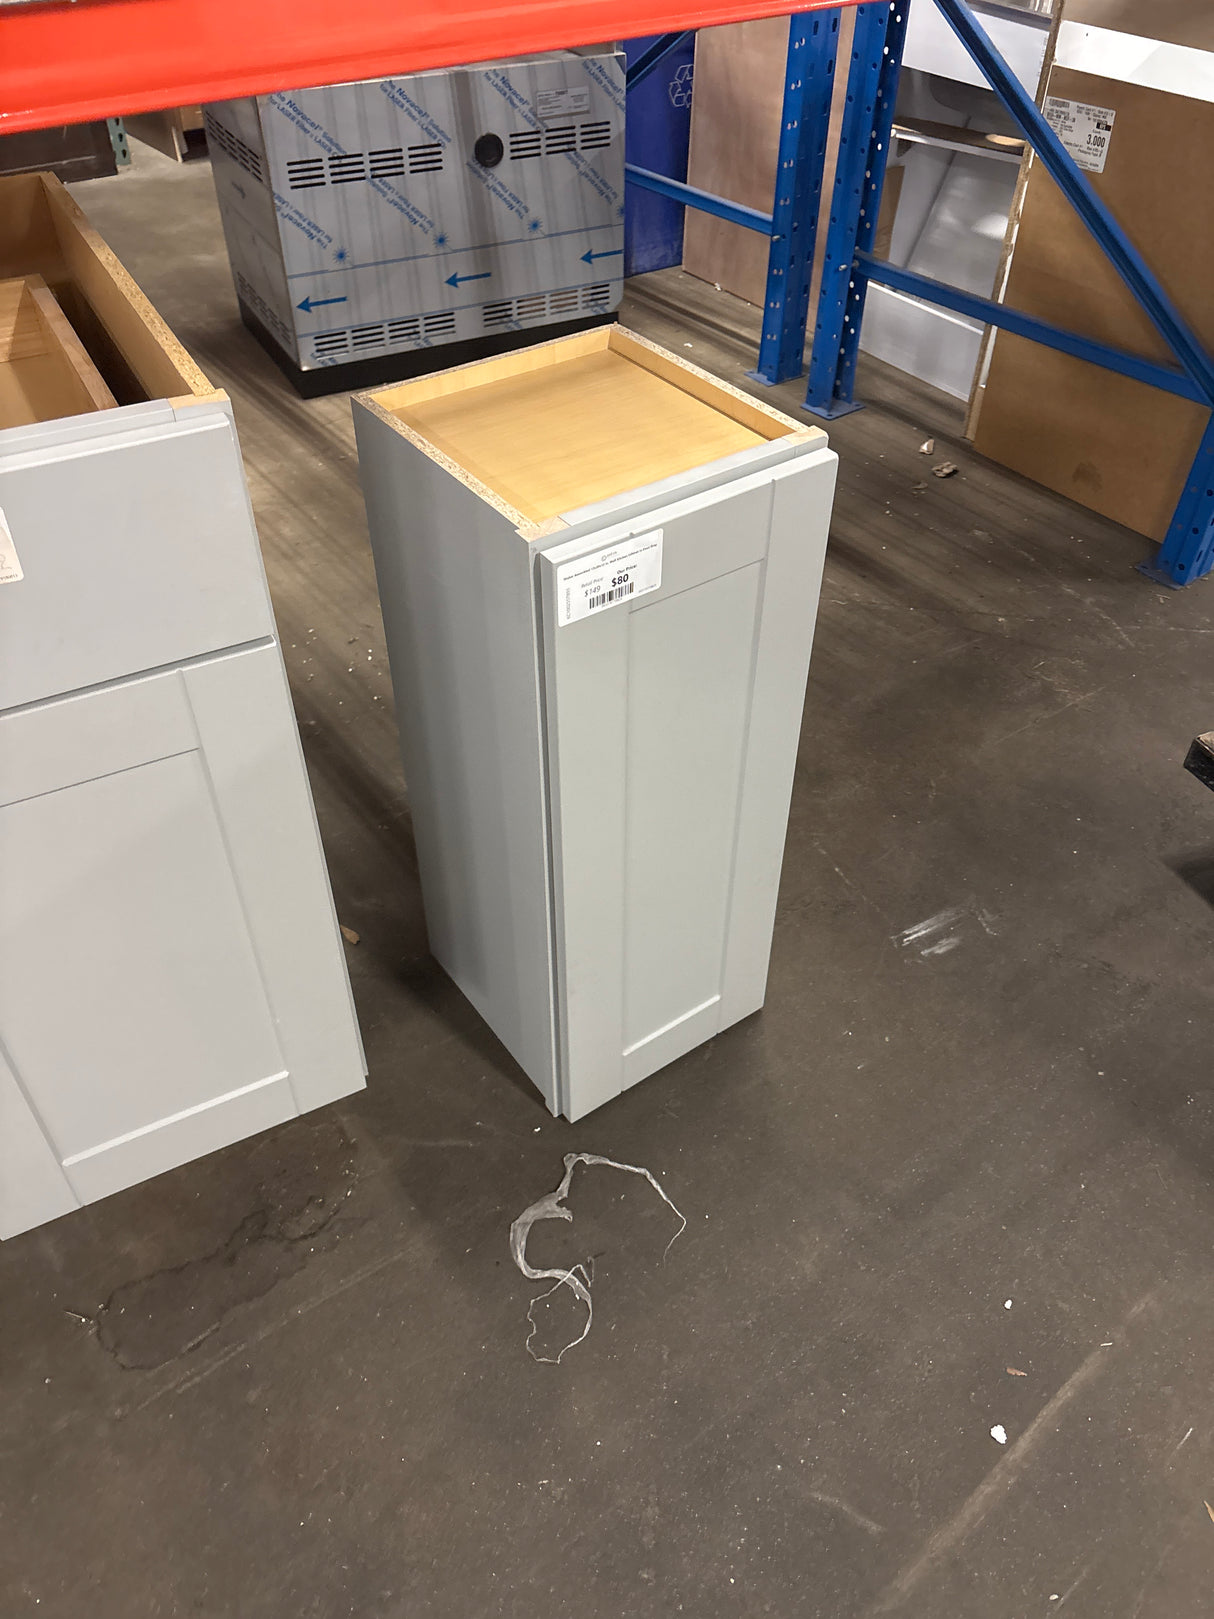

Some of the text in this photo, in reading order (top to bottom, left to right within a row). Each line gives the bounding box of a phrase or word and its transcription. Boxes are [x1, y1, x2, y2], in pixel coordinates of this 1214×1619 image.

[1086, 133, 1106, 148] 3.000
[315, 237, 328, 250] The
[581, 580, 593, 588] Retail
[611, 573, 629, 587] $80
[584, 585, 601, 598] $149
